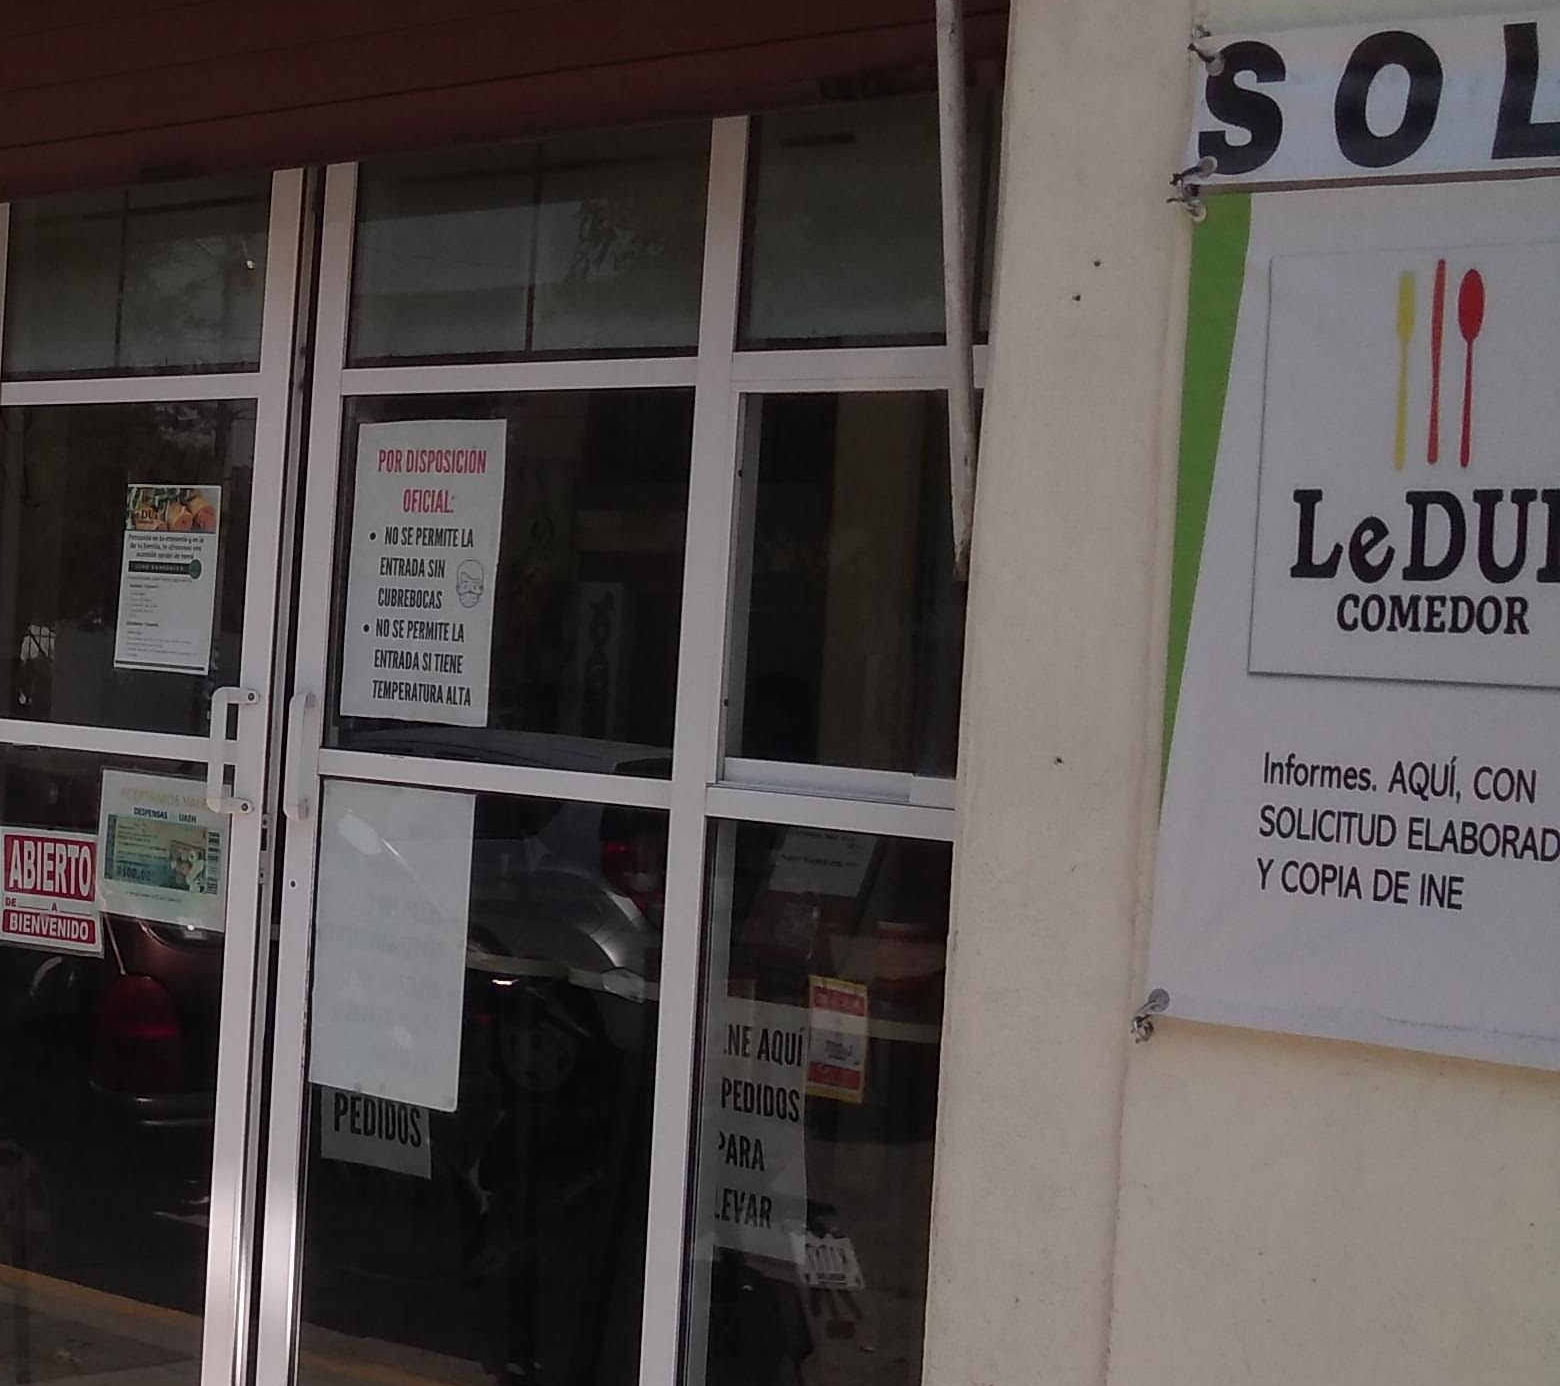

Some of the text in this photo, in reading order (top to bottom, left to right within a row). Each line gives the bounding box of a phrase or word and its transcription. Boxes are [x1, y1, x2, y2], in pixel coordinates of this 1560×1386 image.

[377, 444, 487, 473] POR DISPOSICIÓN
[402, 489, 454, 513] OFICIAL:
[384, 526, 474, 548] NO SE PERMITE LA
[380, 557, 446, 579] ENTRADA SIN
[377, 587, 443, 610] CUBREBOCAS
[1336, 592, 1529, 635] COMEDOR
[376, 618, 465, 643] NO SE PERMITE LA
[374, 649, 464, 674] ENTRADA SI TIENE
[372, 680, 472, 707] TEMPERATURA ALTA
[1262, 751, 1538, 805] Informes. AQUÍ, CON
[1258, 803, 1560, 862] SOLICITUD ELABORAD
[8, 839, 92, 897] ABIERTO
[1256, 857, 1465, 911] Y COPIA DE INE
[5, 897, 58, 912] DE A
[9, 912, 89, 941] BIENVENIDO
[724, 1023, 752, 1058] NE
[756, 1026, 804, 1067] AQUÍ
[721, 1077, 801, 1123] PEDIDOS
[333, 1091, 422, 1148] PEDIDOS
